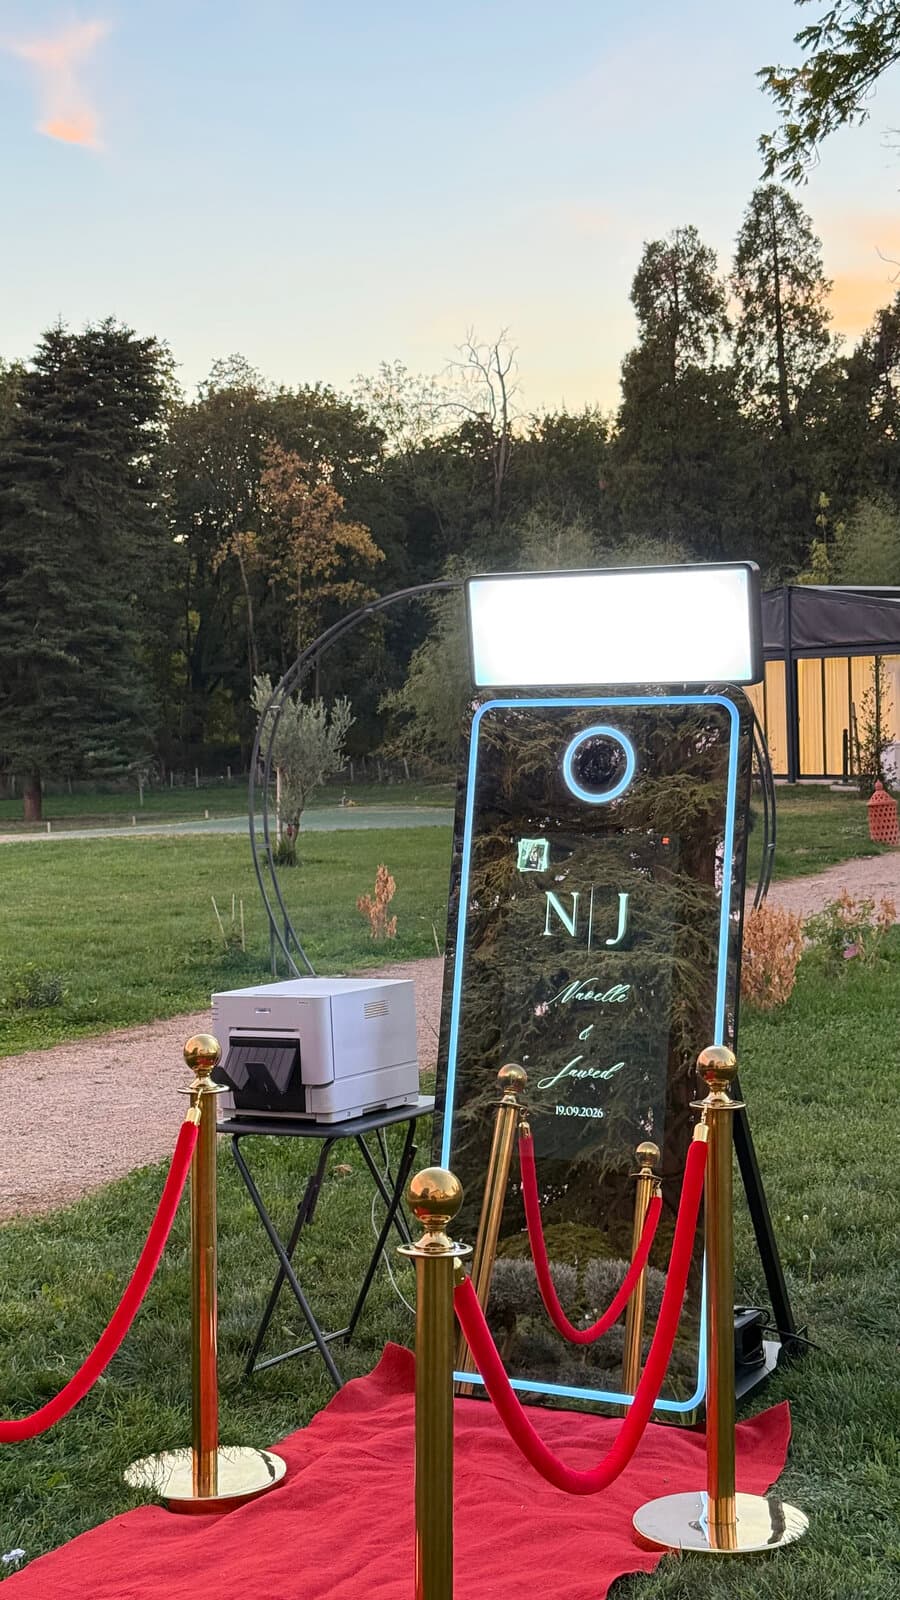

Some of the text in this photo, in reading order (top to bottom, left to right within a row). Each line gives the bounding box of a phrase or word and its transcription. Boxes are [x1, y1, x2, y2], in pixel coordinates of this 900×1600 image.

[543, 891, 630, 945] N J
[537, 1055, 625, 1089] Jawed
[555, 1105, 604, 1119] 19.09.2026
